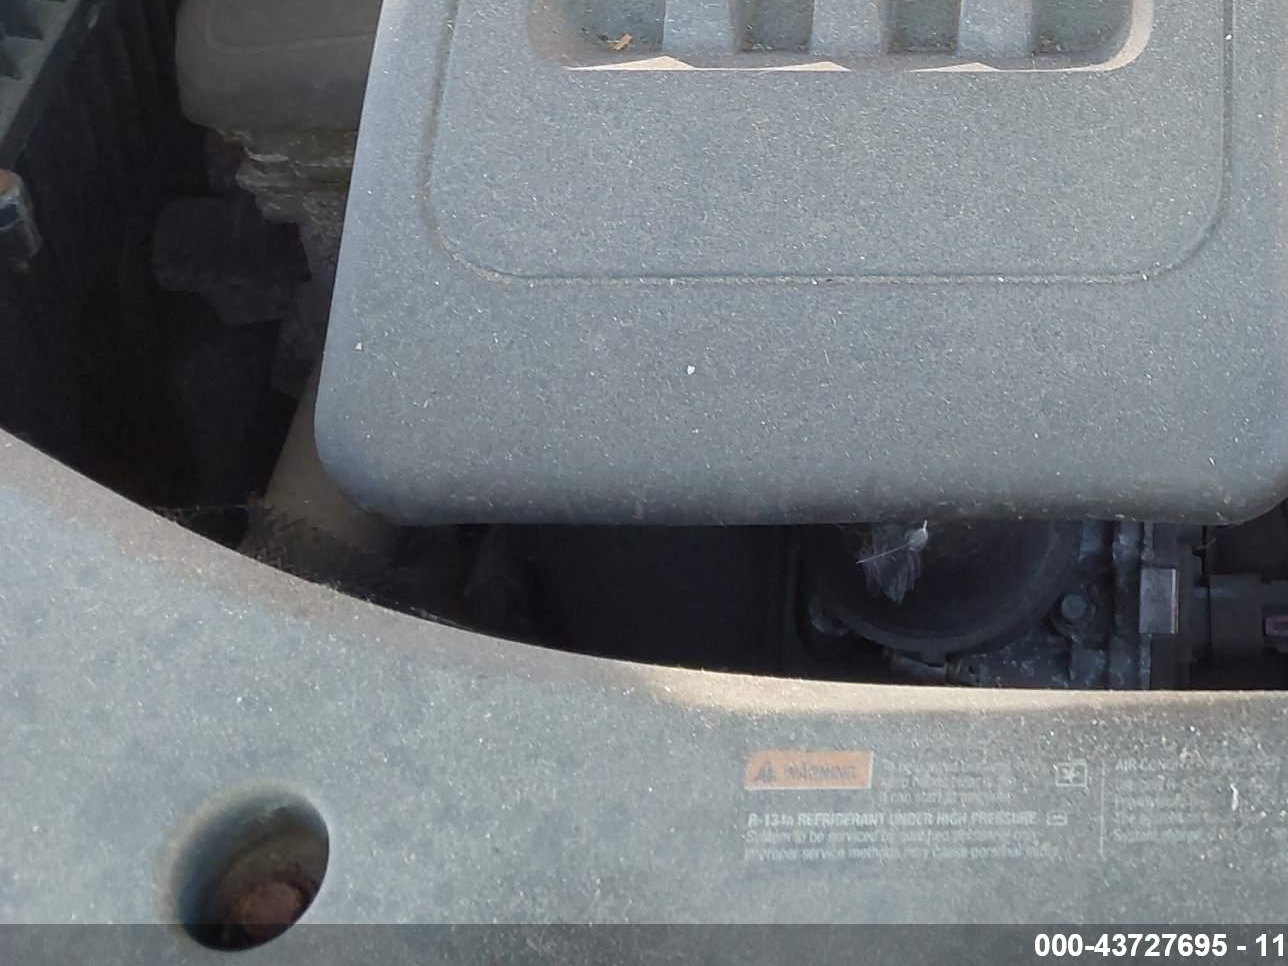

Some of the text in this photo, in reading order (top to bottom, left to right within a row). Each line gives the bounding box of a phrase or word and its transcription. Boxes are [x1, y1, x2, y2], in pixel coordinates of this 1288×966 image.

[797, 812, 885, 827] REFRIGERANT
[889, 811, 934, 826] UNDER
[936, 811, 968, 825] HIGH
[970, 810, 1038, 825] PRESSURE
